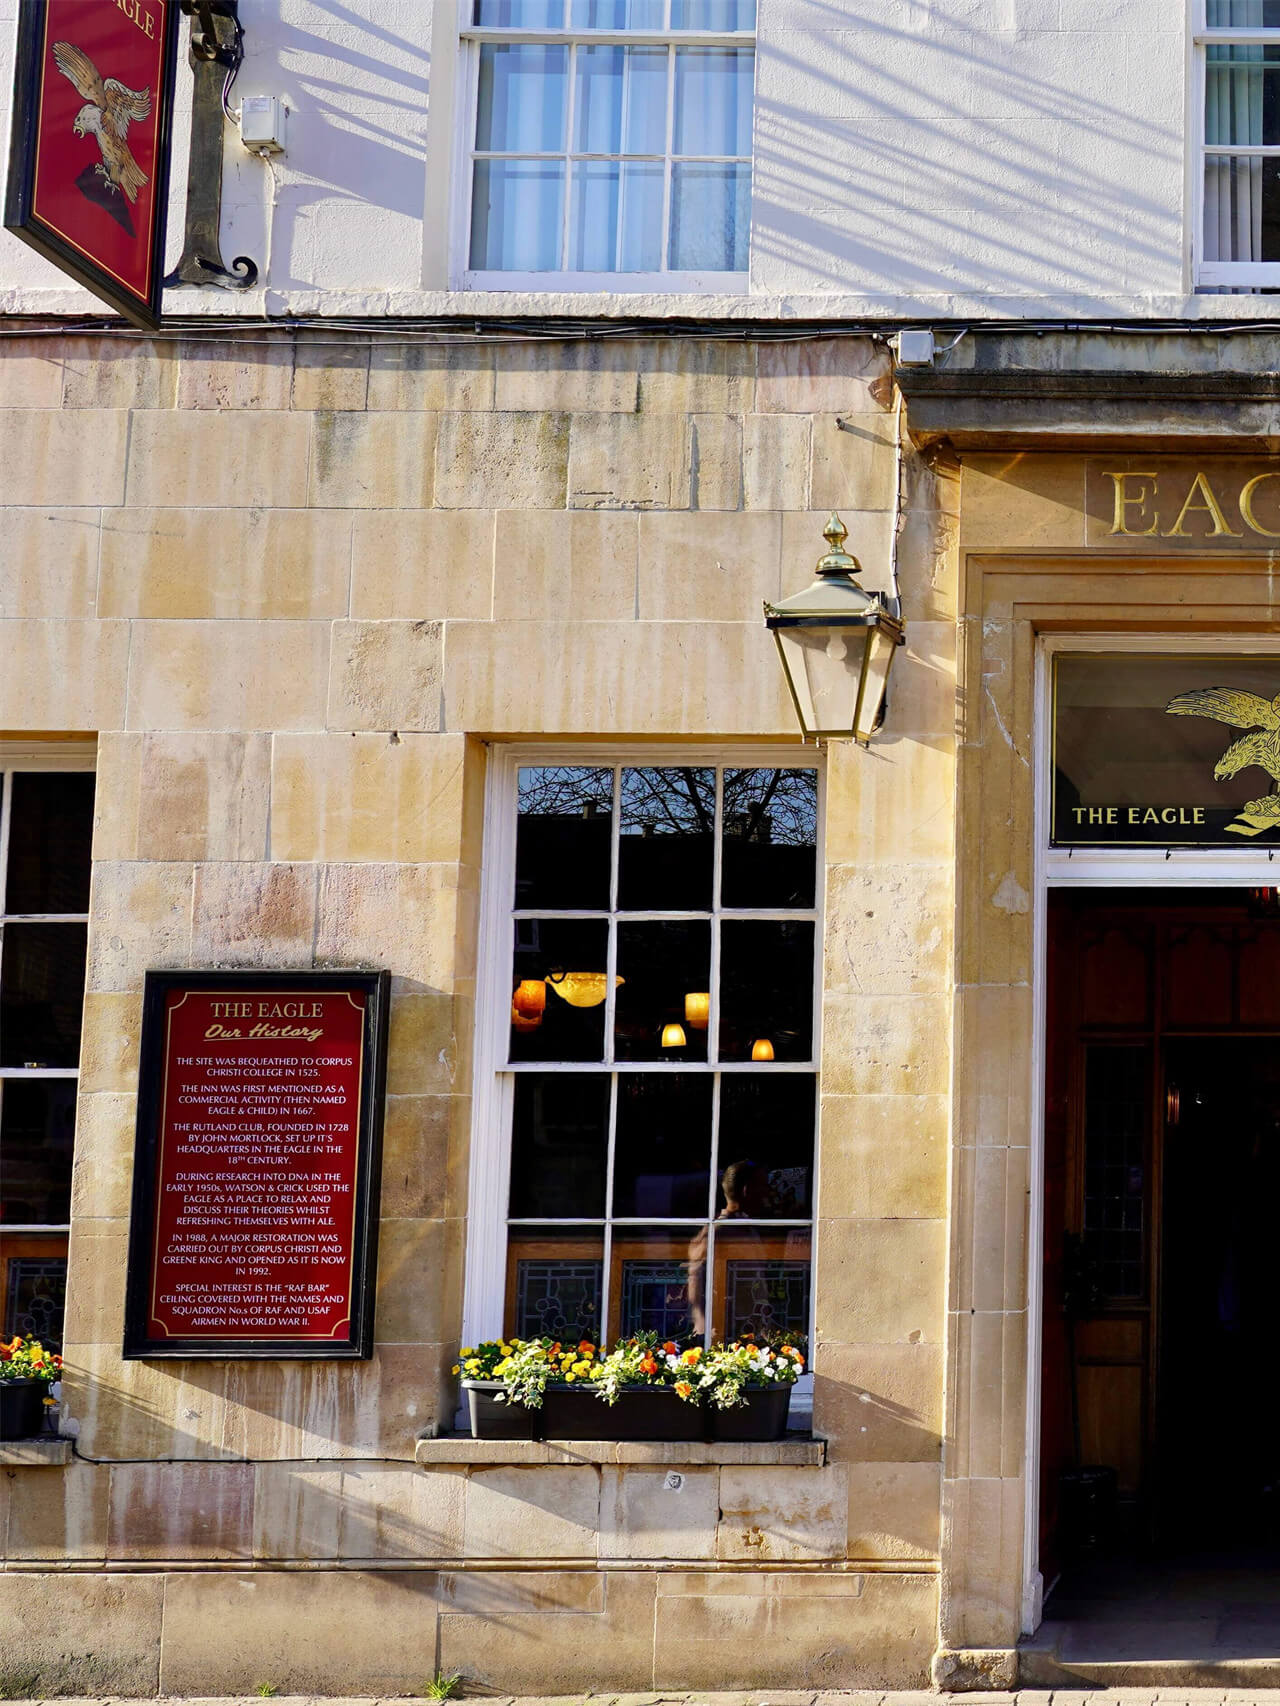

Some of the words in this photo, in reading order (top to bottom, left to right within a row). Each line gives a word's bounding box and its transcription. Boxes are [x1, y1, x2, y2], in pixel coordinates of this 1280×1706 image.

[1071, 807, 1118, 824] THE
[1128, 807, 1206, 824] EAGLE
[210, 1002, 252, 1018] THE
[257, 1002, 323, 1018] EAGLE
[204, 1024, 242, 1038] Our
[249, 1022, 324, 1042] History
[176, 1057, 194, 1066] THE
[195, 1057, 213, 1066] SITE
[215, 1057, 236, 1066] WAS
[238, 1057, 299, 1067] BEQUEATHED
[300, 1057, 314, 1066] TO
[315, 1057, 353, 1066] CORPUS
[206, 1068, 241, 1077] CHRISTI
[242, 1068, 283, 1077] COLLEGE
[285, 1068, 296, 1077] IN
[298, 1068, 321, 1077] 1525.
[181, 1084, 198, 1093] THE
[200, 1085, 218, 1093] INN
[220, 1084, 241, 1093] WAS
[242, 1084, 266, 1093] FIRST
[267, 1084, 323, 1093] MENTIONED
[324, 1084, 337, 1094] AS
[337, 1085, 345, 1093] A
[178, 1095, 239, 1104] COMMERCIAL
[240, 1095, 282, 1104] ACTIVITY
[283, 1095, 311, 1104] (THEN
[312, 1095, 347, 1104] NAMED
[208, 1106, 236, 1115] EAGLE
[237, 1107, 245, 1115] &
[246, 1106, 278, 1116] CHILD)
[280, 1106, 290, 1115] IN
[293, 1106, 316, 1115] 1667.
[173, 1123, 191, 1131] THE
[192, 1123, 237, 1132] RUTLAND
[238, 1123, 265, 1132] CLUB,
[267, 1123, 314, 1132] FOUNDED
[315, 1123, 326, 1132] IN
[328, 1123, 349, 1132] 1728
[188, 1134, 201, 1142] BY
[201, 1133, 228, 1144] JOHN
[229, 1134, 283, 1143] MORTLOCK,
[285, 1134, 301, 1143] SET
[302, 1134, 316, 1143] UP
[177, 1145, 250, 1155] HEADQUARTERS
[251, 1145, 262, 1153] IN
[264, 1145, 281, 1154] THE
[283, 1145, 311, 1154] EAGLE
[313, 1145, 324, 1153] IN
[325, 1145, 343, 1154] THE
[246, 1156, 292, 1165] CENTURY.
[176, 1172, 214, 1181] DURING
[215, 1172, 261, 1181] RESEARCH
[263, 1172, 287, 1181] INTO
[288, 1172, 310, 1181] DNA
[311, 1173, 322, 1181] IN
[323, 1172, 341, 1182] THE
[166, 1183, 194, 1192] EARLY
[224, 1183, 266, 1192] WATSON
[267, 1184, 275, 1192] &
[276, 1183, 304, 1192] CRICK
[306, 1183, 330, 1193] USED
[332, 1183, 350, 1192] THE
[183, 1194, 212, 1203] EAGLE
[213, 1194, 225, 1203] AS
[226, 1195, 234, 1203] A
[235, 1194, 263, 1203] PLACE
[265, 1194, 279, 1203] TO
[280, 1194, 308, 1204] RELAX
[309, 1194, 332, 1204] AND
[183, 1205, 222, 1215] DISCUSS
[223, 1206, 249, 1214] THEIR
[251, 1205, 294, 1215] THEORIES
[295, 1206, 331, 1215] WHILST
[176, 1216, 232, 1226] REFRESHING
[233, 1216, 289, 1226] THEMSELVES
[290, 1217, 316, 1225] WITH
[316, 1217, 336, 1226] ALE.
[172, 1234, 183, 1242] IN
[186, 1233, 208, 1243] 1988,
[210, 1234, 218, 1242] A
[219, 1233, 251, 1243] MAJOR
[252, 1233, 316, 1242] RESTORATION
[317, 1233, 339, 1242] WAS
[167, 1244, 207, 1253] CARRIED
[208, 1244, 229, 1253] OUT
[231, 1245, 243, 1253] BY
[244, 1244, 283, 1254] CORPUS
[283, 1244, 319, 1254] CHRISTI
[320, 1244, 343, 1254] AND
[162, 1255, 197, 1264] GREENE
[199, 1255, 223, 1264] KING
[224, 1255, 246, 1264] AND
[247, 1255, 286, 1264] OPENED
[286, 1255, 299, 1265] AS
[300, 1256, 309, 1264] IT
[311, 1255, 319, 1265] IS
[320, 1255, 346, 1265] NOW
[235, 1267, 246, 1276] IN
[248, 1267, 272, 1276] 1992.
[175, 1283, 210, 1292] SPECIAL
[212, 1283, 252, 1292] INTEREST
[254, 1283, 263, 1292] IS
[264, 1283, 282, 1292] THE
[159, 1294, 196, 1304] CEILING
[197, 1294, 241, 1304] COVERED
[242, 1295, 268, 1303] WITH
[270, 1295, 287, 1304] THE
[289, 1294, 321, 1304] NAMES
[322, 1295, 344, 1304] AND
[172, 1306, 227, 1316] SQUADRON
[249, 1306, 263, 1315] OF
[264, 1306, 282, 1314] RAF
[283, 1306, 306, 1315] AND
[307, 1306, 331, 1315] USAF
[191, 1317, 227, 1326] AIRMEN
[228, 1317, 239, 1326] IN
[240, 1317, 277, 1326] WORLD
[278, 1317, 300, 1326] WAR
[302, 1317, 310, 1326] II.
